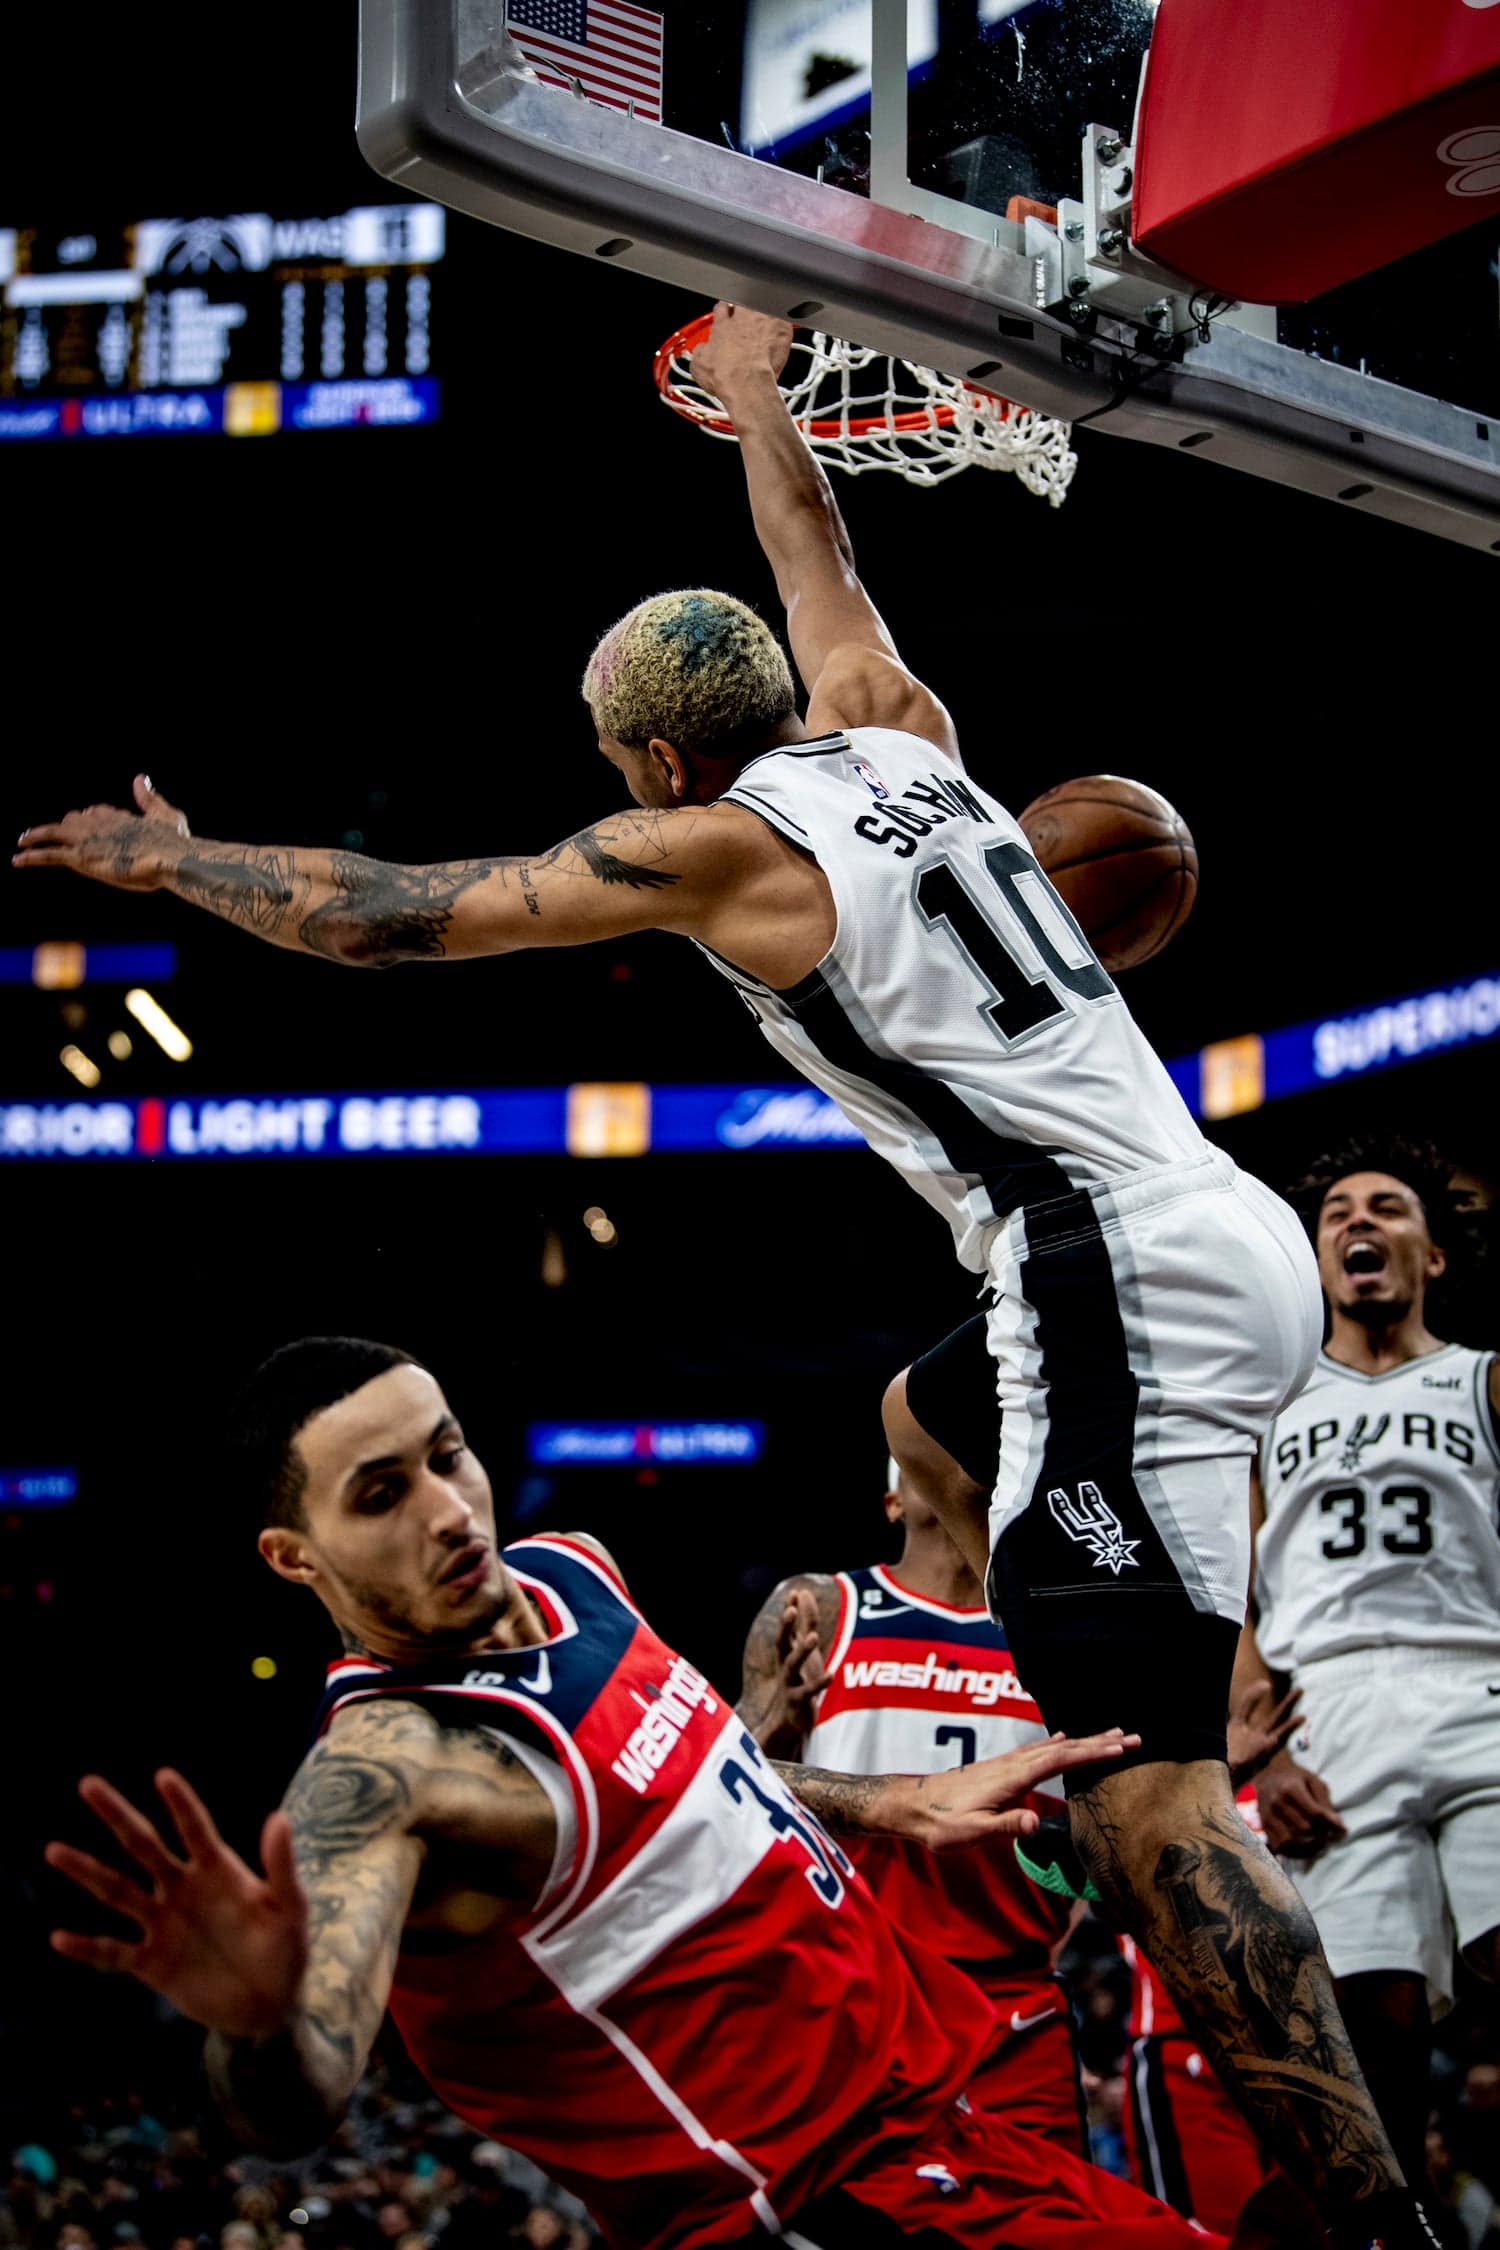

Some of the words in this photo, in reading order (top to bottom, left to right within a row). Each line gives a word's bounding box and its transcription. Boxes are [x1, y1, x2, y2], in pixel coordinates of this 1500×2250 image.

[911, 836, 1121, 1053] 10
[1312, 977, 1500, 1079] SUPERIO
[0, 1102, 134, 1156] RIOR
[169, 1098, 334, 1155] LIGHT
[340, 1095, 480, 1152] BEER
[1277, 1413, 1475, 1481] SPURS
[1320, 1485, 1434, 1561] 33
[611, 1655, 718, 1794] washingt
